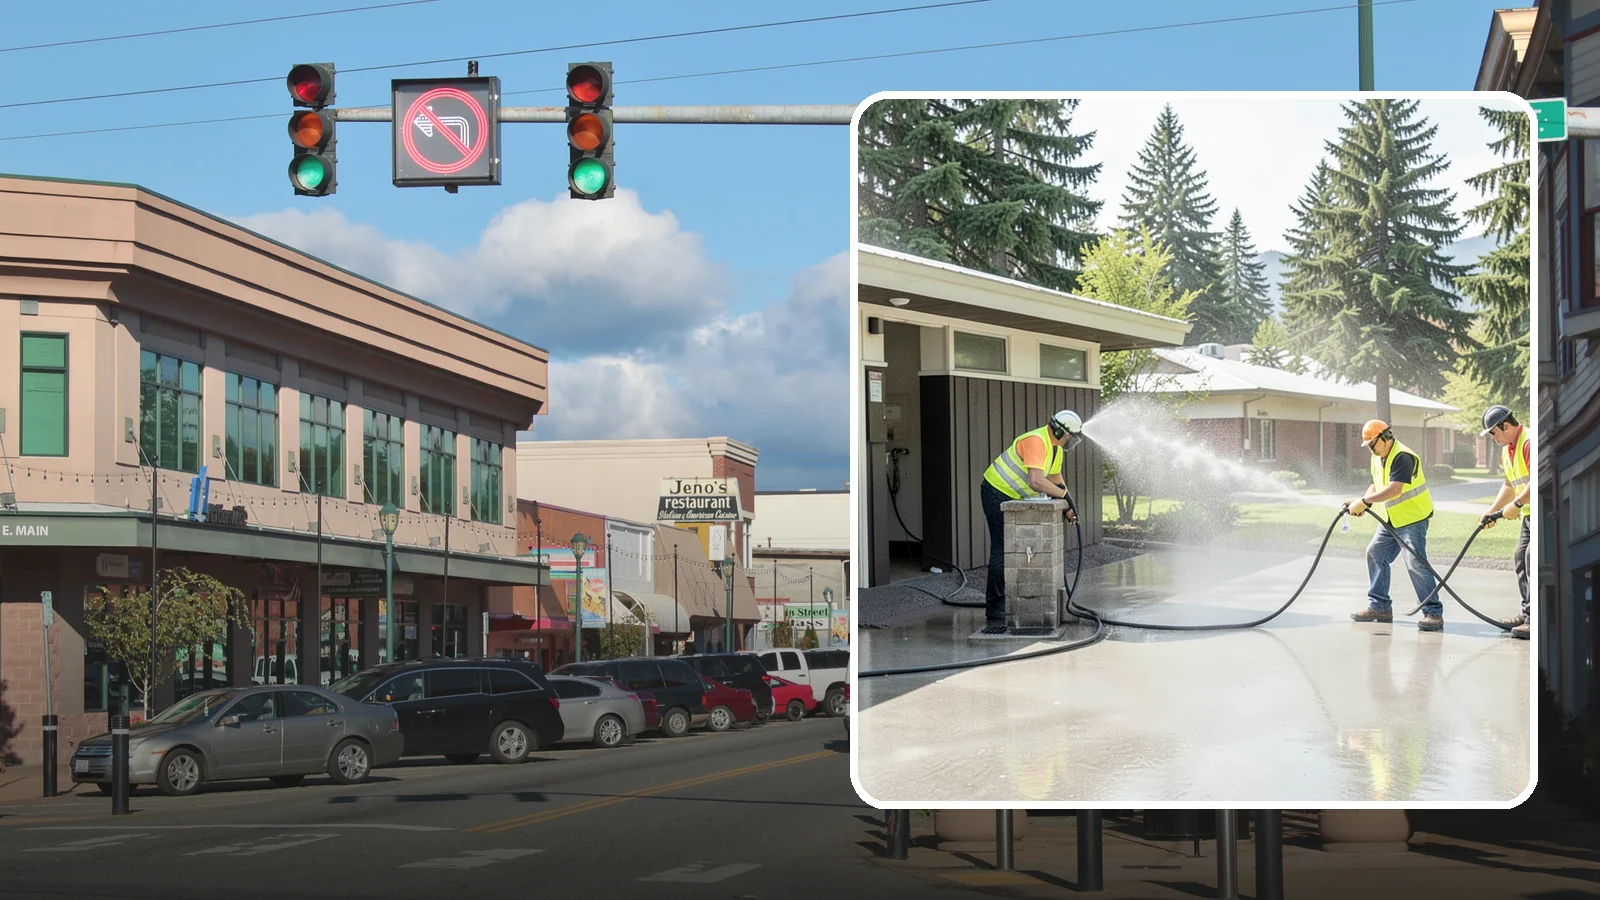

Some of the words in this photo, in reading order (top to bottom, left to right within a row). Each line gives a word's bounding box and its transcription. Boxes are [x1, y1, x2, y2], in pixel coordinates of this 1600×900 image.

[670, 480, 727, 494] Jeno's
[665, 497, 730, 508] restaurant
[659, 510, 681, 519] Italian
[686, 510, 714, 519] American
[715, 510, 737, 519] Cuisine
[2, 525, 13, 536] E.
[15, 525, 49, 536] MAIN
[797, 608, 828, 617] Street
